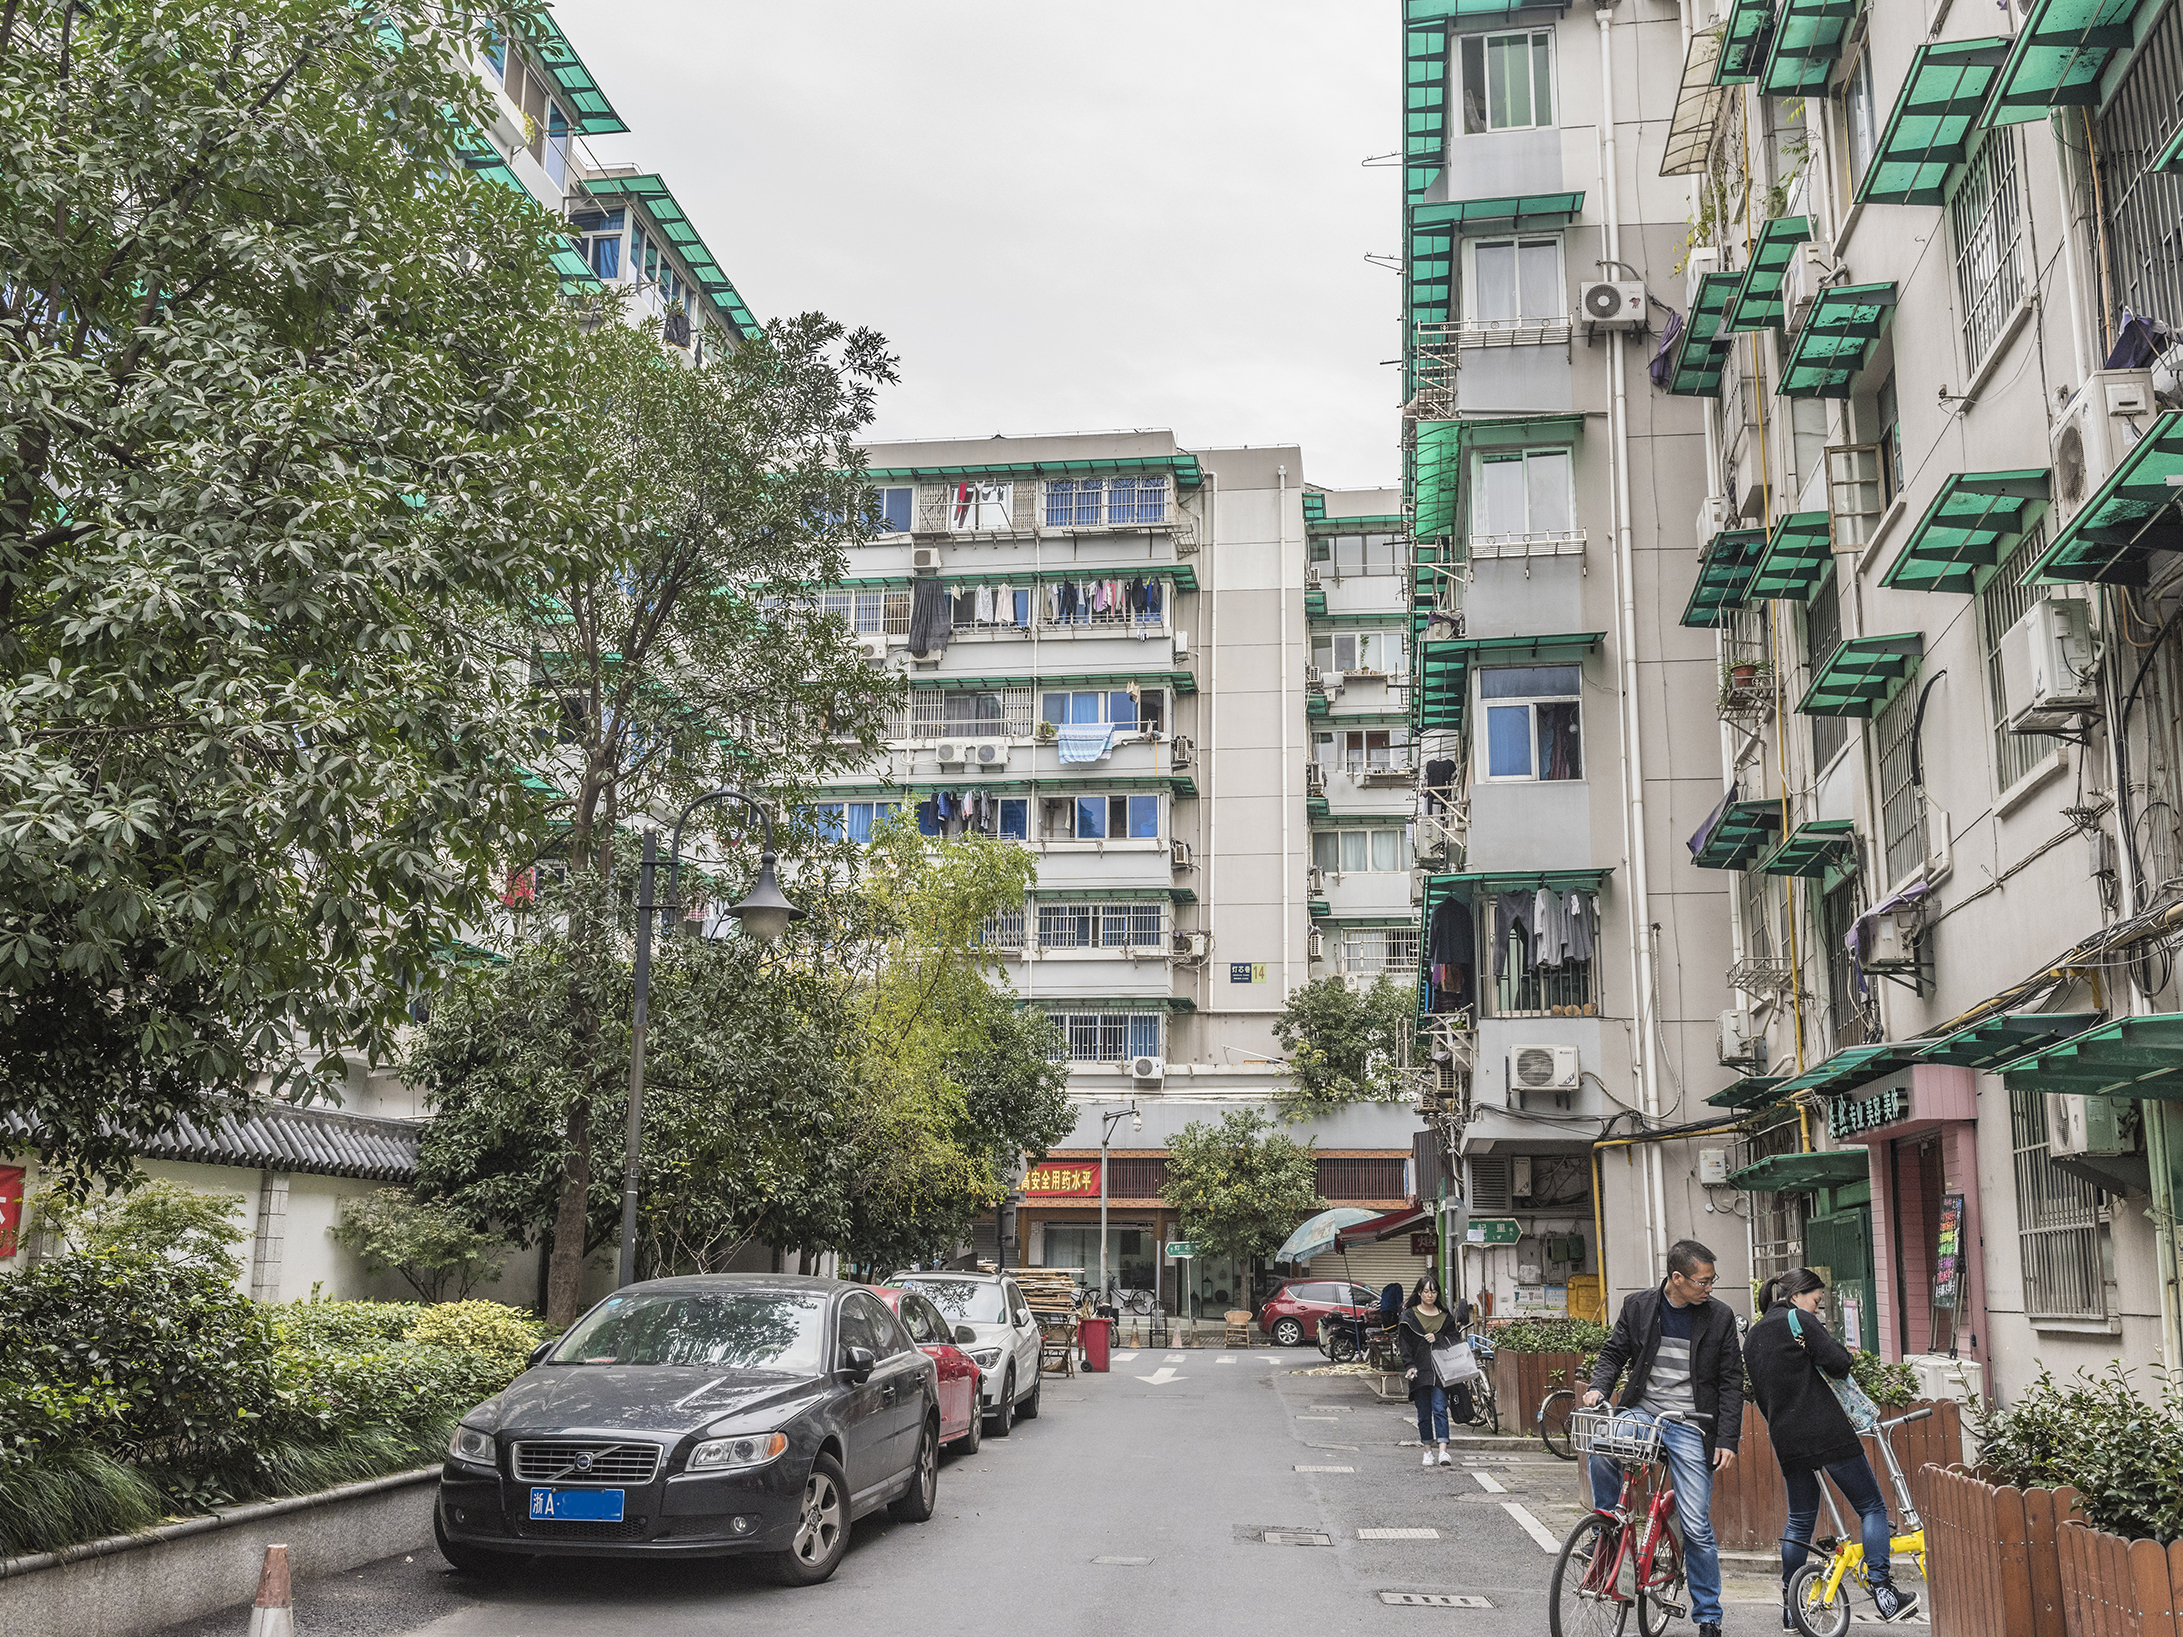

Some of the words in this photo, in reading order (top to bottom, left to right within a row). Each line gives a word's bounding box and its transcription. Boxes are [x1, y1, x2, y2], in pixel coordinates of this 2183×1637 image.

[1253, 965, 1265, 980] 14
[1015, 1169, 1093, 1191] 高安全用药水平
